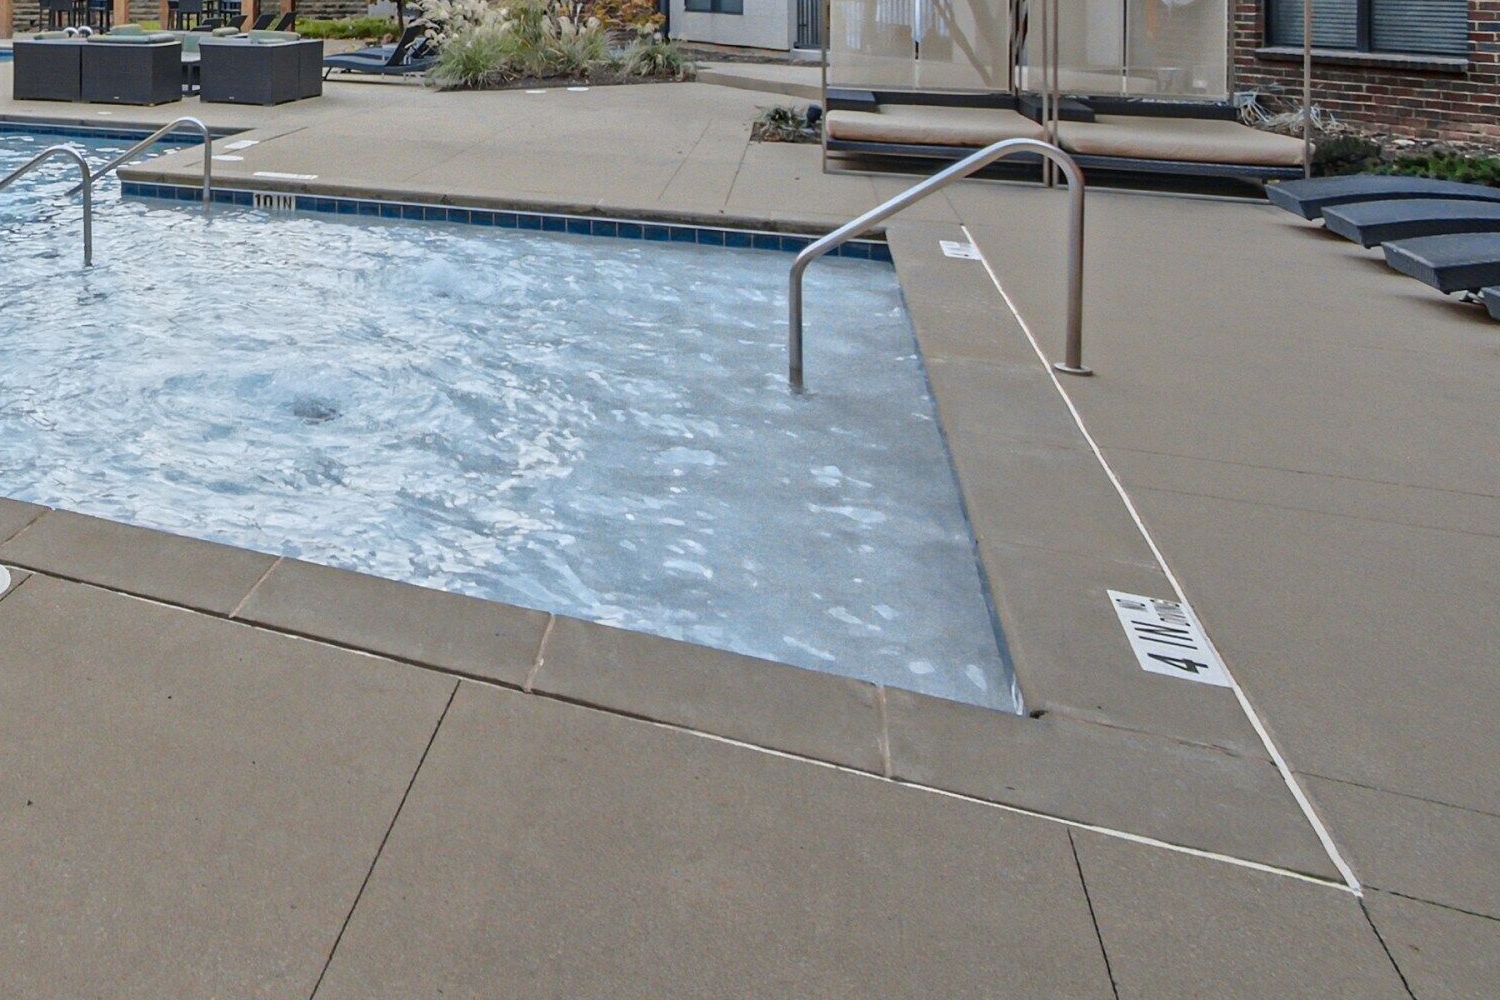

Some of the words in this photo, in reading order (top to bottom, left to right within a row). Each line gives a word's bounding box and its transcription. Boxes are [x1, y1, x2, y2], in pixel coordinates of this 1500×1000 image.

[255, 194, 273, 206] 10
[277, 195, 292, 209] IN
[1130, 619, 1198, 650] IN
[1146, 652, 1209, 674] 4
